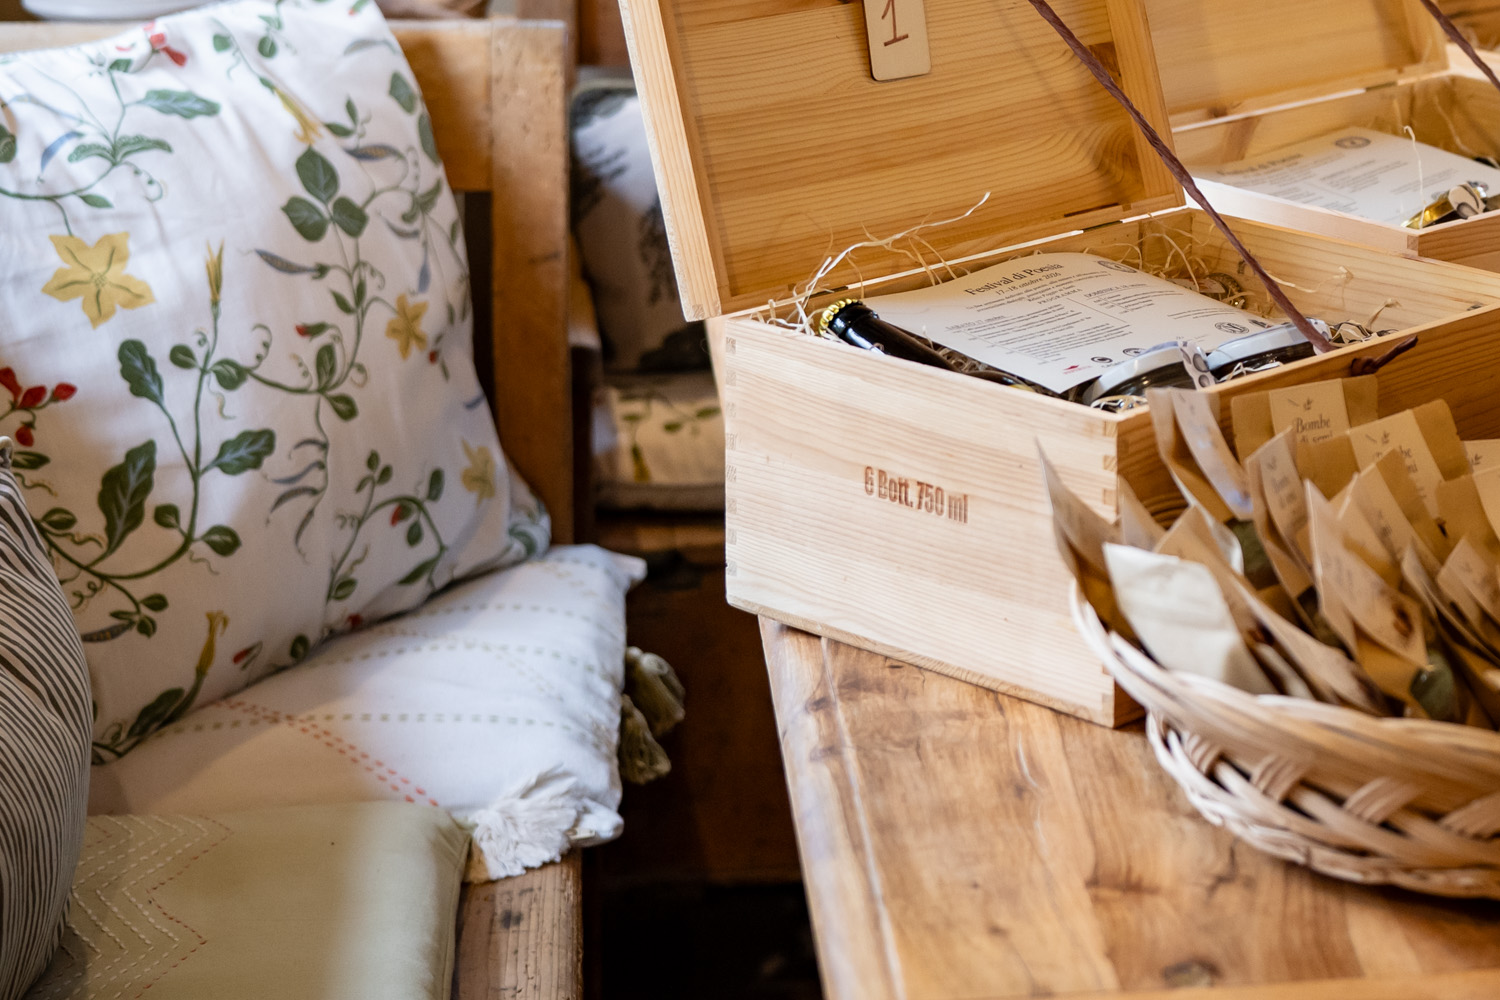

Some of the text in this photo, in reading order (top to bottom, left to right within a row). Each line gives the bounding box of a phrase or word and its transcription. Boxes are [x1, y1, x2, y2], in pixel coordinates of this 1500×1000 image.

[965, 264, 1064, 296] Festival di Poesia
[1294, 412, 1331, 433] Bombe
[864, 466, 968, 523] 6 Bott. 750 ml
